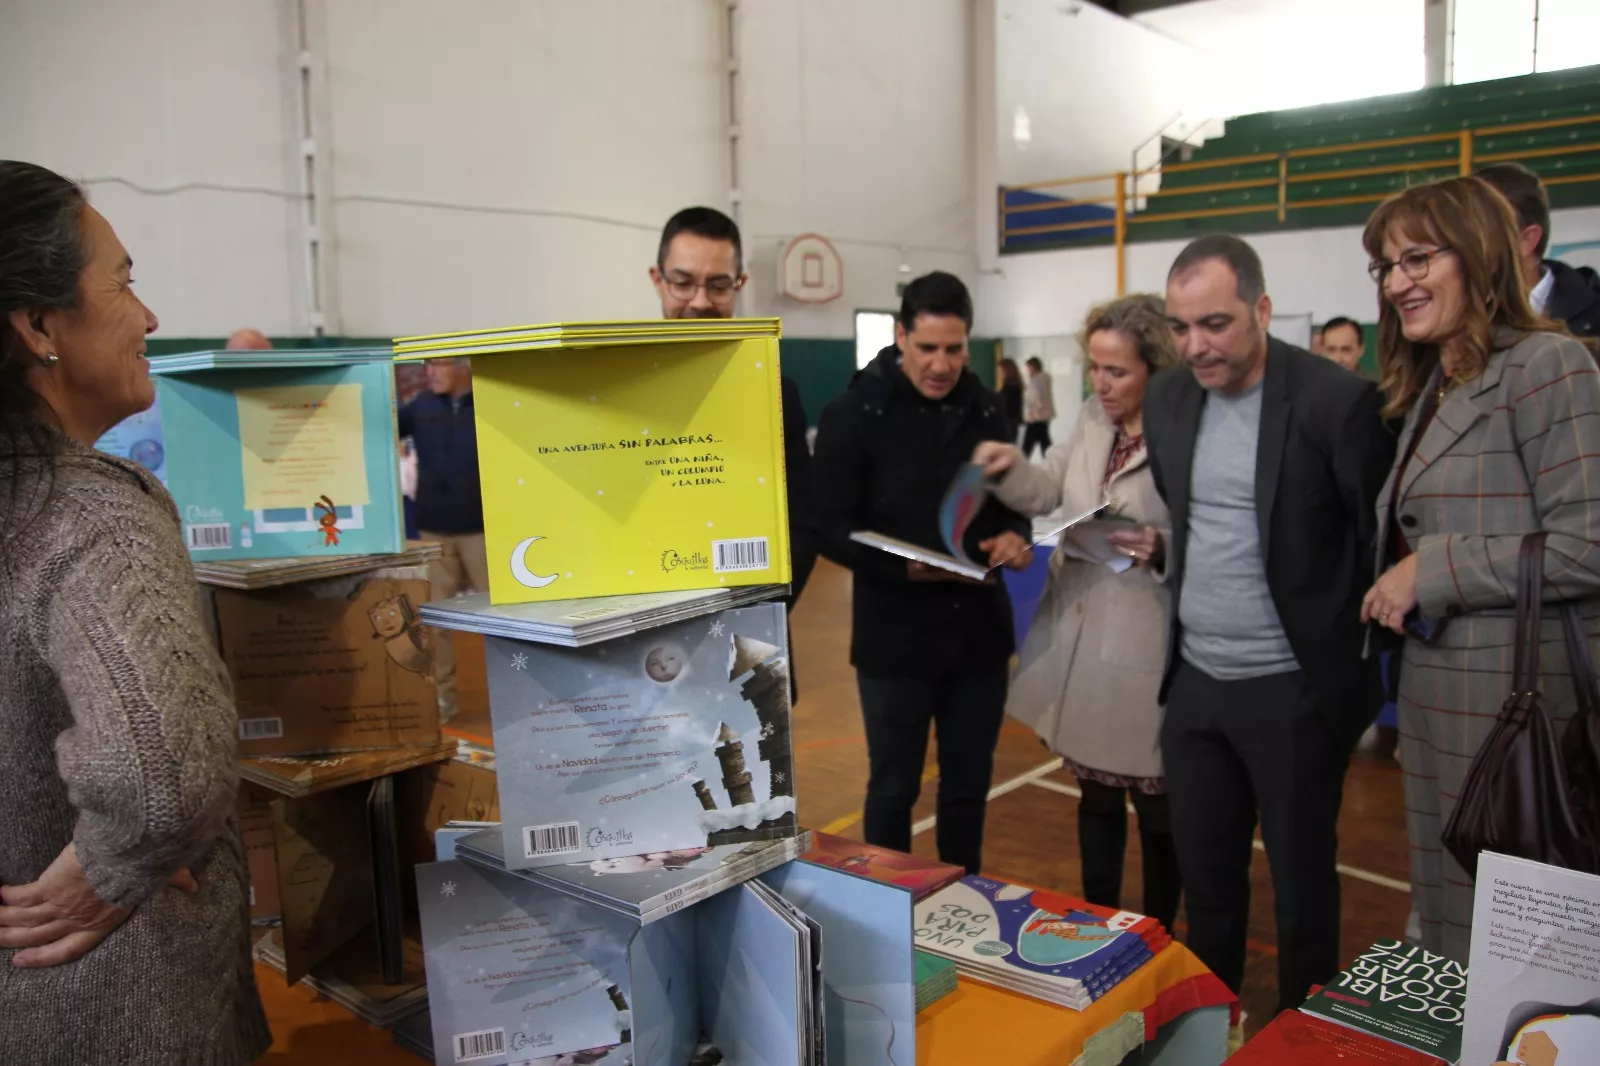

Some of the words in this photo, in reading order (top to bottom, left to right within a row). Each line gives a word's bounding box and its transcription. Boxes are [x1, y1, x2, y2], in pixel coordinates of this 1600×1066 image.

[538, 446, 560, 455] UNA
[562, 443, 616, 454] AVENTURA
[618, 439, 641, 450] SIN
[645, 433, 723, 448] PALABRAS...
[669, 456, 690, 464] UNA
[693, 453, 724, 463] NIÑA,
[660, 468, 675, 476] UN
[677, 465, 725, 475] COLUMPIO
[679, 479, 693, 487] LA
[695, 477, 725, 486] LUNA.
[660, 549, 709, 574] Cosquillas
[573, 703, 608, 714] Renata
[562, 756, 598, 767] Navidad
[676, 760, 699, 781] paces?
[664, 888, 683, 901] GATA
[1493, 878, 1509, 888] Este
[1510, 882, 1534, 893] cuento
[1544, 890, 1560, 899] una
[665, 900, 684, 913] GATA
[1493, 888, 1527, 900] mezclado
[1528, 894, 1563, 910] leyendas,
[1564, 903, 1596, 918] familia,
[936, 904, 991, 924] DOS
[1491, 907, 1516, 917] sueños
[1517, 912, 1523, 921] y
[1525, 914, 1565, 931] preguntas,
[1527, 905, 1540, 914] por
[1541, 909, 1576, 922] supuesto,
[924, 912, 987, 938] PARA
[1505, 925, 1529, 936] cuento
[1541, 934, 1552, 942] un
[915, 928, 964, 949] UNO
[1488, 950, 1526, 964] preguntas,
[1508, 944, 1521, 953] que
[1528, 939, 1557, 953] familia,
[1559, 949, 1580, 959] amor
[488, 970, 522, 980] Navidad
